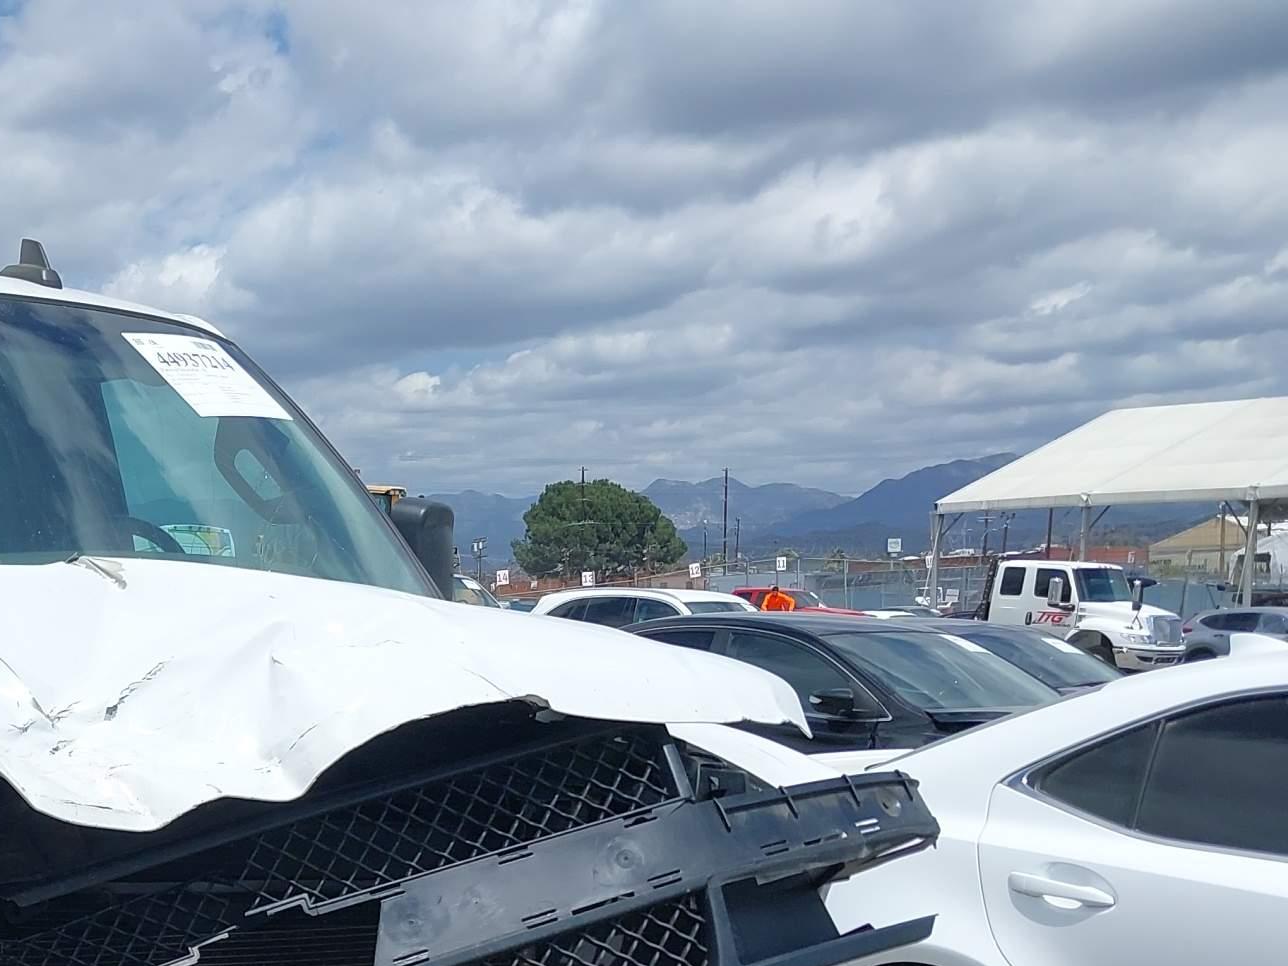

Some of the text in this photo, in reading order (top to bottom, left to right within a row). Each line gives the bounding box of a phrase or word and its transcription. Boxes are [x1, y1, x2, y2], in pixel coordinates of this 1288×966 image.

[156, 351, 235, 371] 44937214
[777, 559, 787, 569] 11
[691, 565, 701, 576] 12
[497, 572, 508, 583] 14
[583, 574, 594, 584] 13
